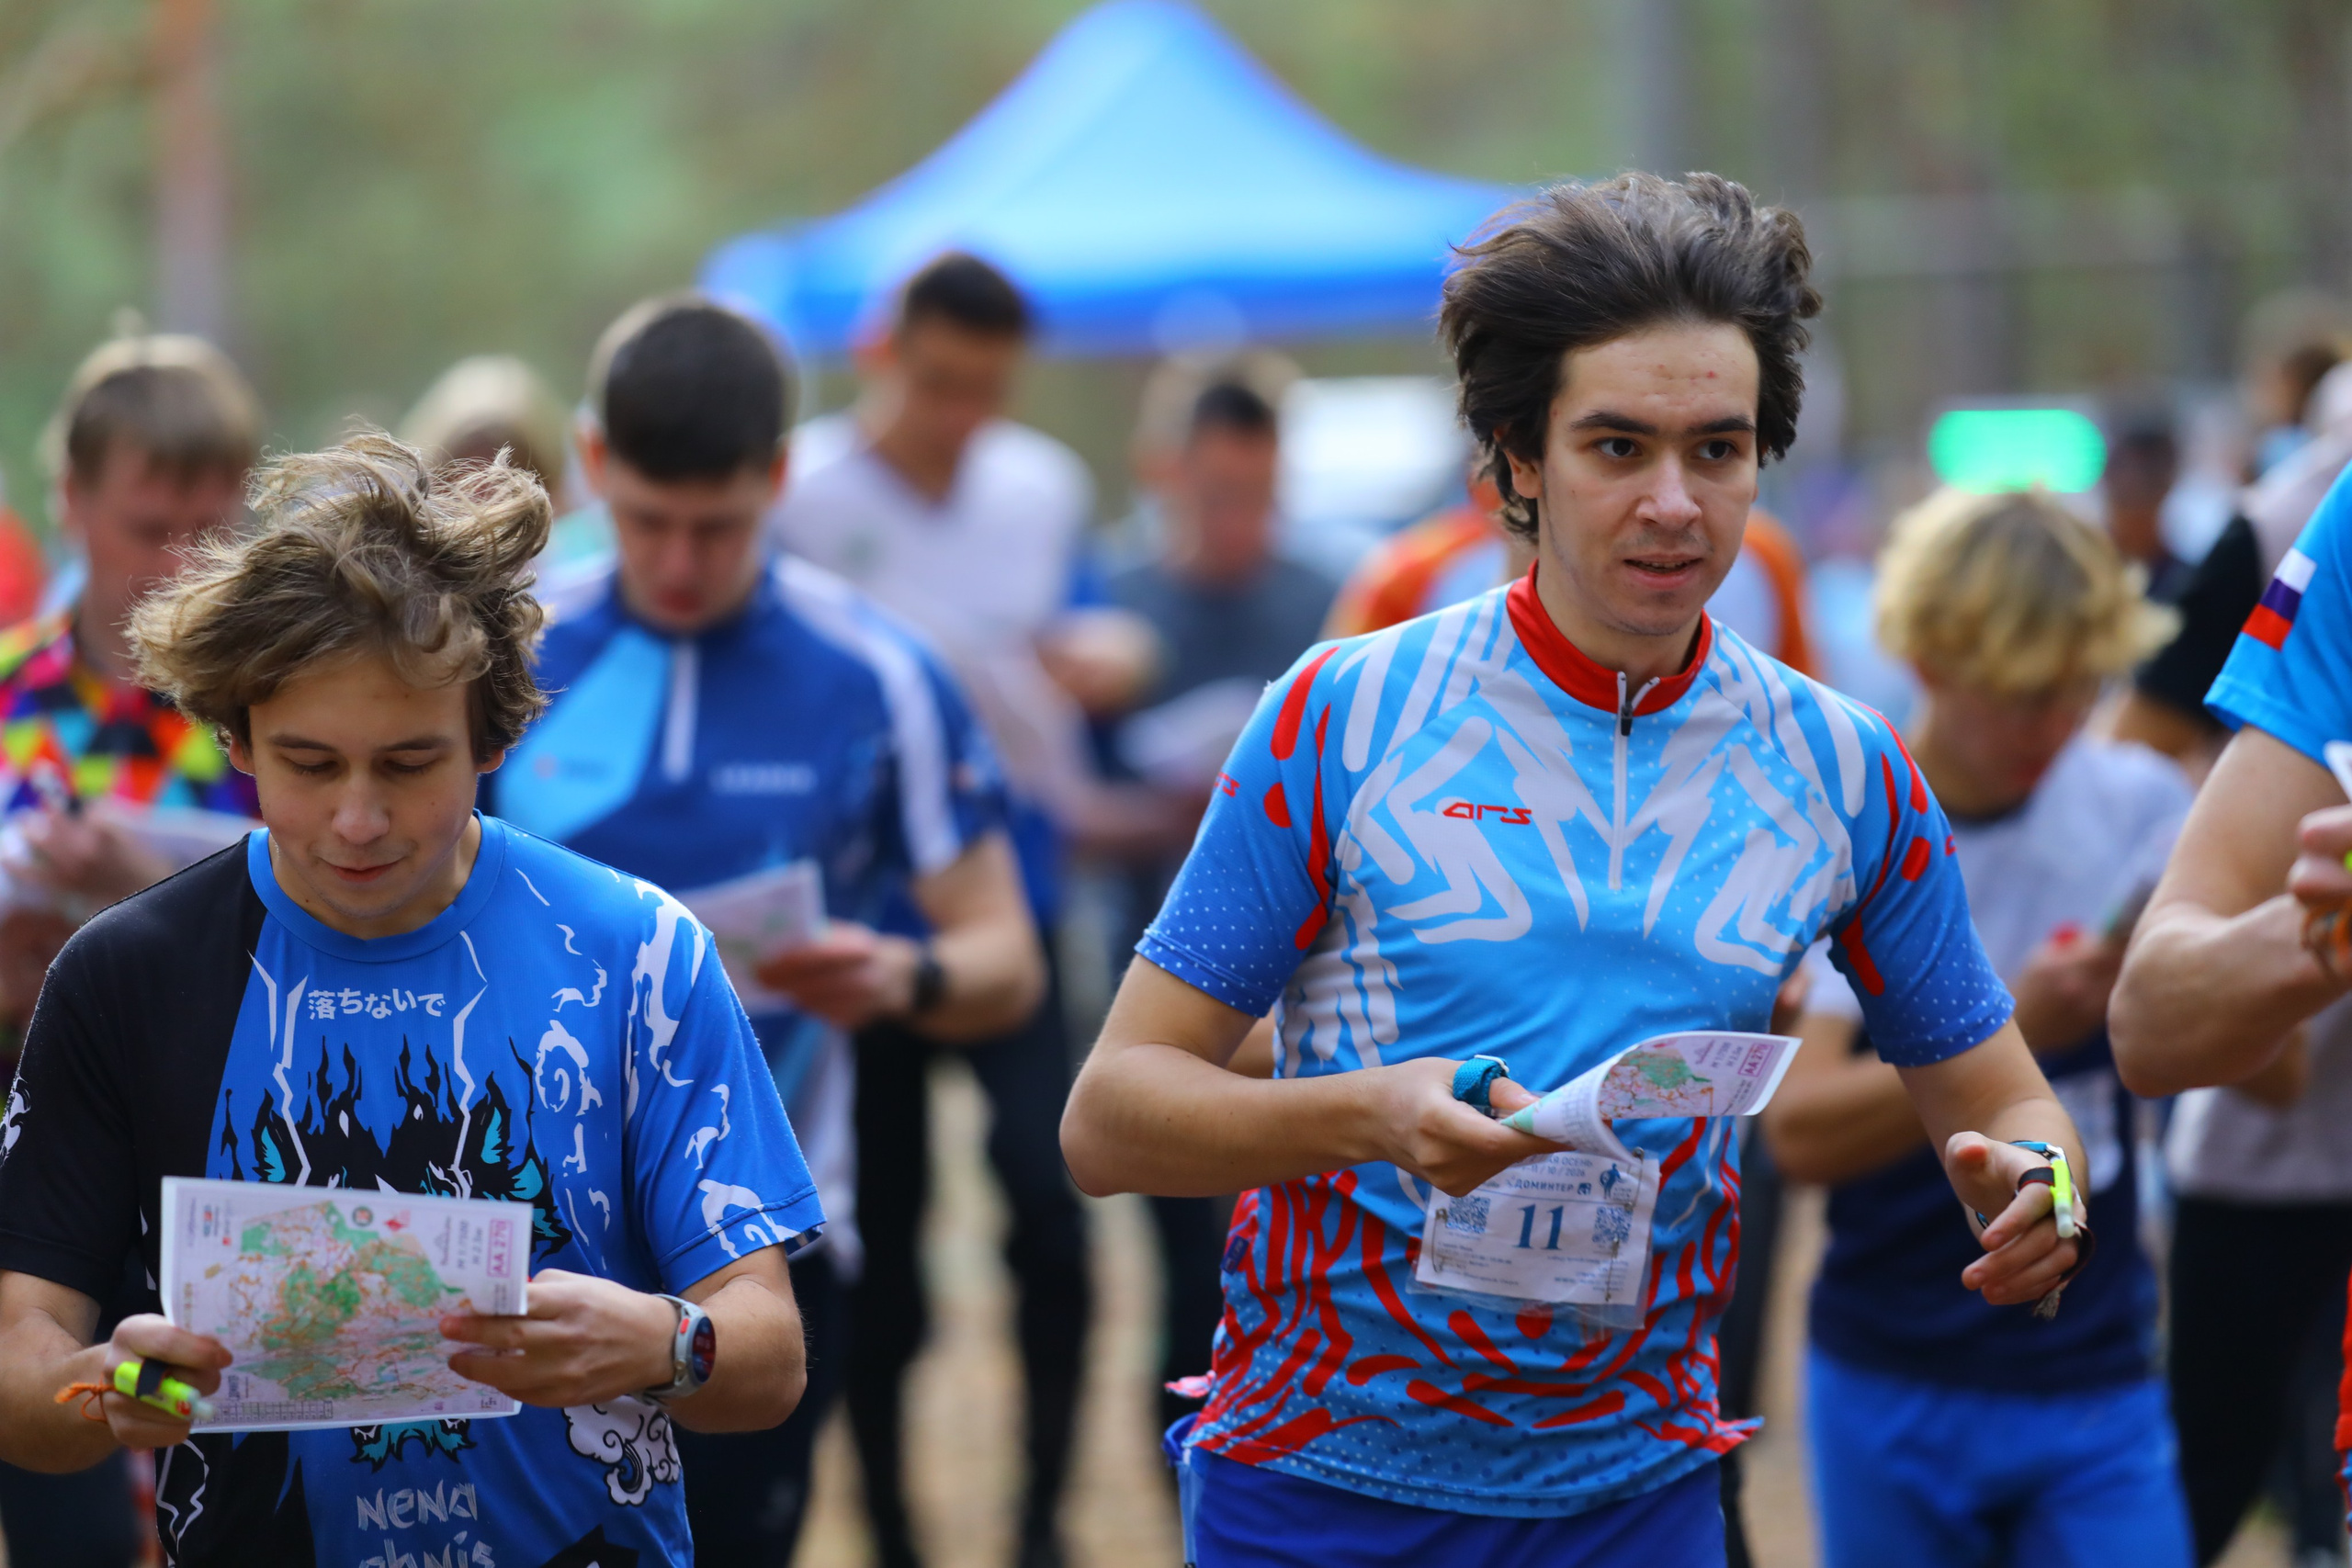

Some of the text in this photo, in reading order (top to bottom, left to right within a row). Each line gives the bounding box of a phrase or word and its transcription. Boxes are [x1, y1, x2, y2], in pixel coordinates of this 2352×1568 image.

[308, 987, 447, 1021] 落ちないで
[1514, 1203, 1565, 1250] 11
